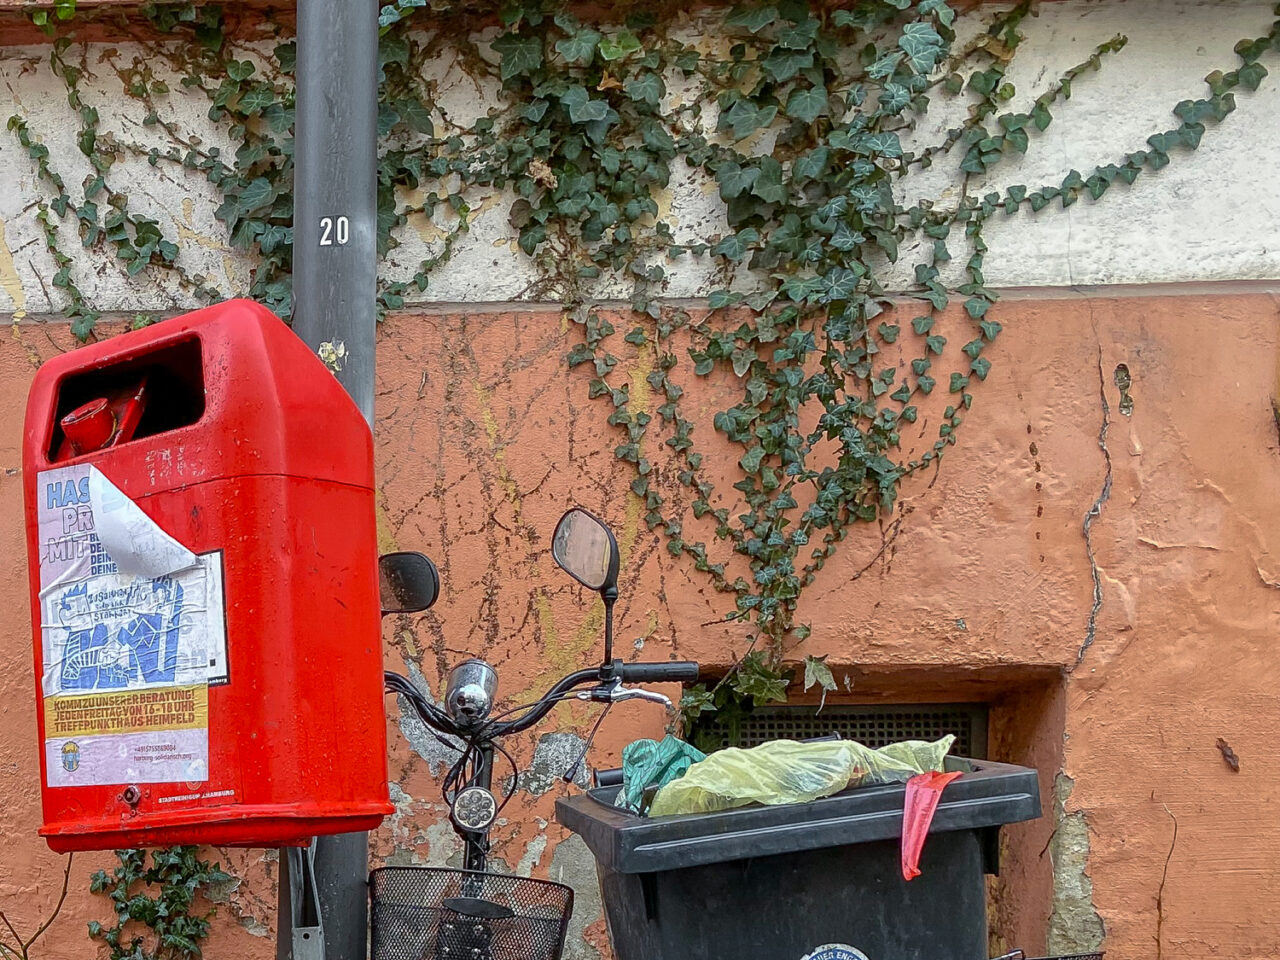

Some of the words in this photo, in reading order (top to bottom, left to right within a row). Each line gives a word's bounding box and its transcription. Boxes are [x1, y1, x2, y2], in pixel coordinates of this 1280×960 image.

[319, 216, 349, 246] 20
[62, 504, 96, 534] PR
[47, 534, 88, 563] MIT
[54, 699, 81, 711] KOMM
[81, 697, 96, 709] ZU
[96, 695, 139, 708] UNSERER
[140, 689, 195, 704] BERATUNG!
[55, 710, 84, 721] JEDEN
[84, 707, 122, 720] FREITAG
[122, 705, 144, 716] VON
[144, 704, 155, 715] 16
[174, 701, 195, 712] UHR
[145, 712, 195, 726] HEIMFELD
